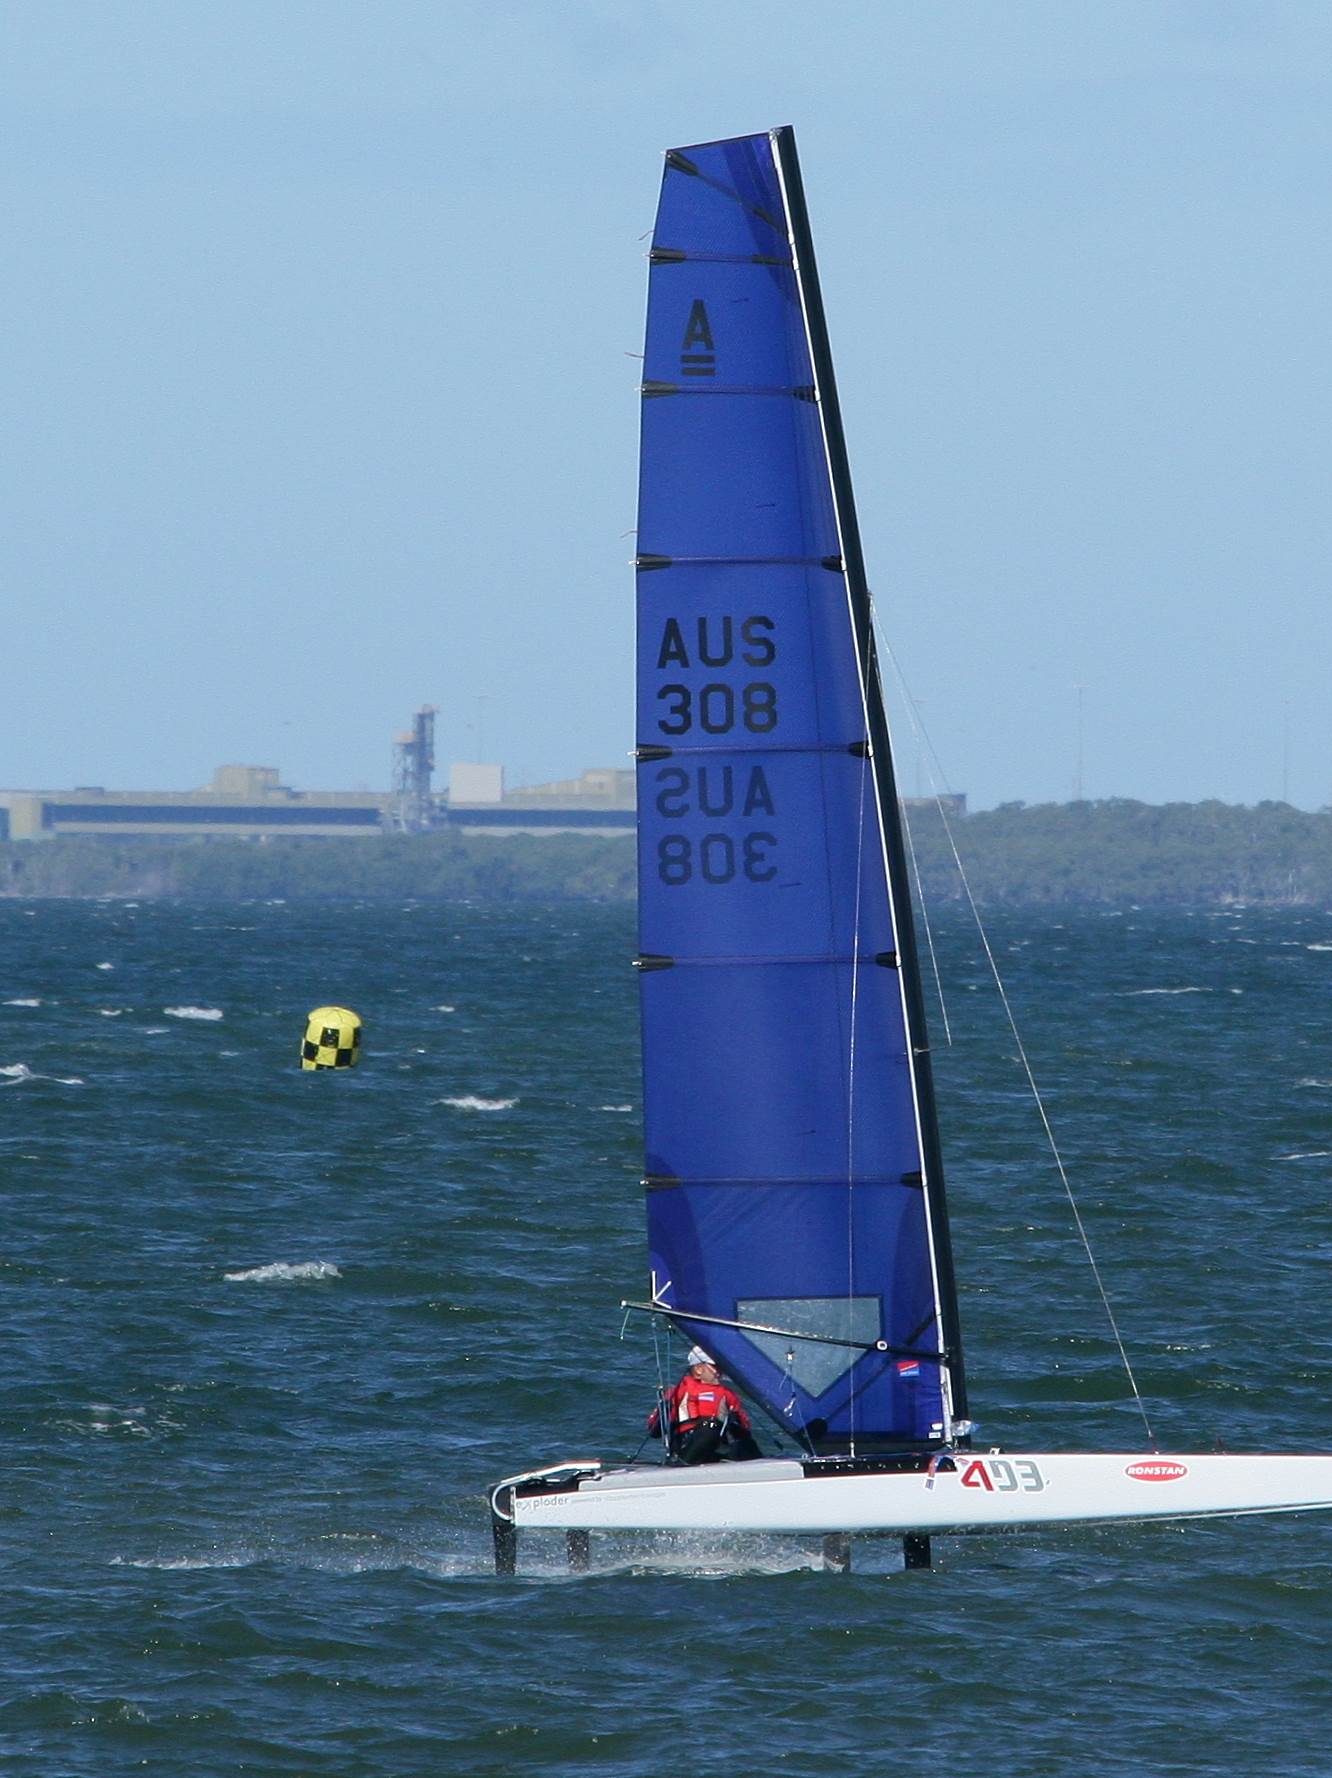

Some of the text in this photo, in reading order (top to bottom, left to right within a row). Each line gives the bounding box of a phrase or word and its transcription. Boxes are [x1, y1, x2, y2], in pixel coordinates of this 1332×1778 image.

[682, 299, 714, 350] A
[657, 616, 776, 668] AUS
[657, 683, 778, 735] 308
[1127, 1466, 1185, 1476] RONSTAN
